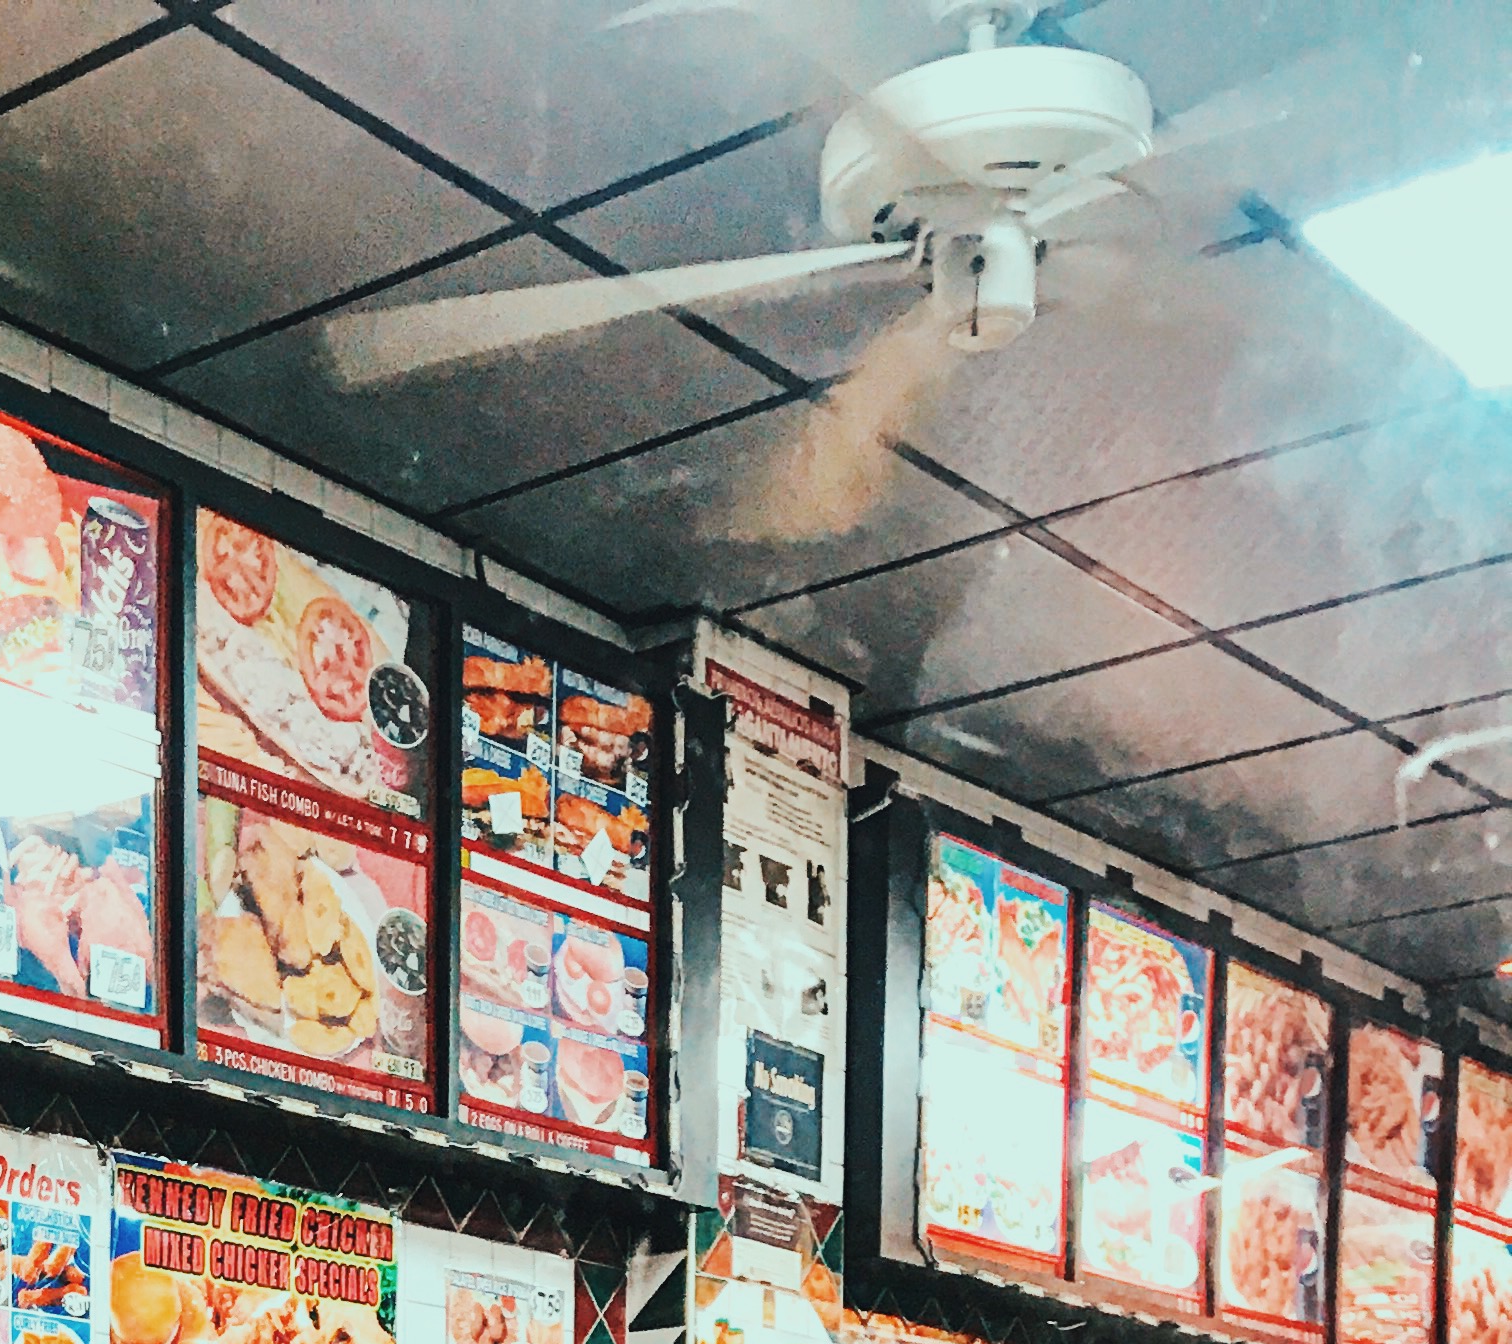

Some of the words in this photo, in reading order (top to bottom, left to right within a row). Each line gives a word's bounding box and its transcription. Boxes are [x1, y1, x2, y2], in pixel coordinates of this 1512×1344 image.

[216, 767, 247, 794] TUNA
[251, 779, 277, 804] FISH
[281, 790, 319, 819] COMBO
[117, 1168, 227, 1228] KENNEDY
[230, 1191, 297, 1241] FRIED
[300, 1207, 393, 1262] CHICKEN
[144, 1225, 205, 1276] MIXED
[209, 1239, 291, 1291] CHICKEN
[295, 1255, 379, 1307] SPECIALS
